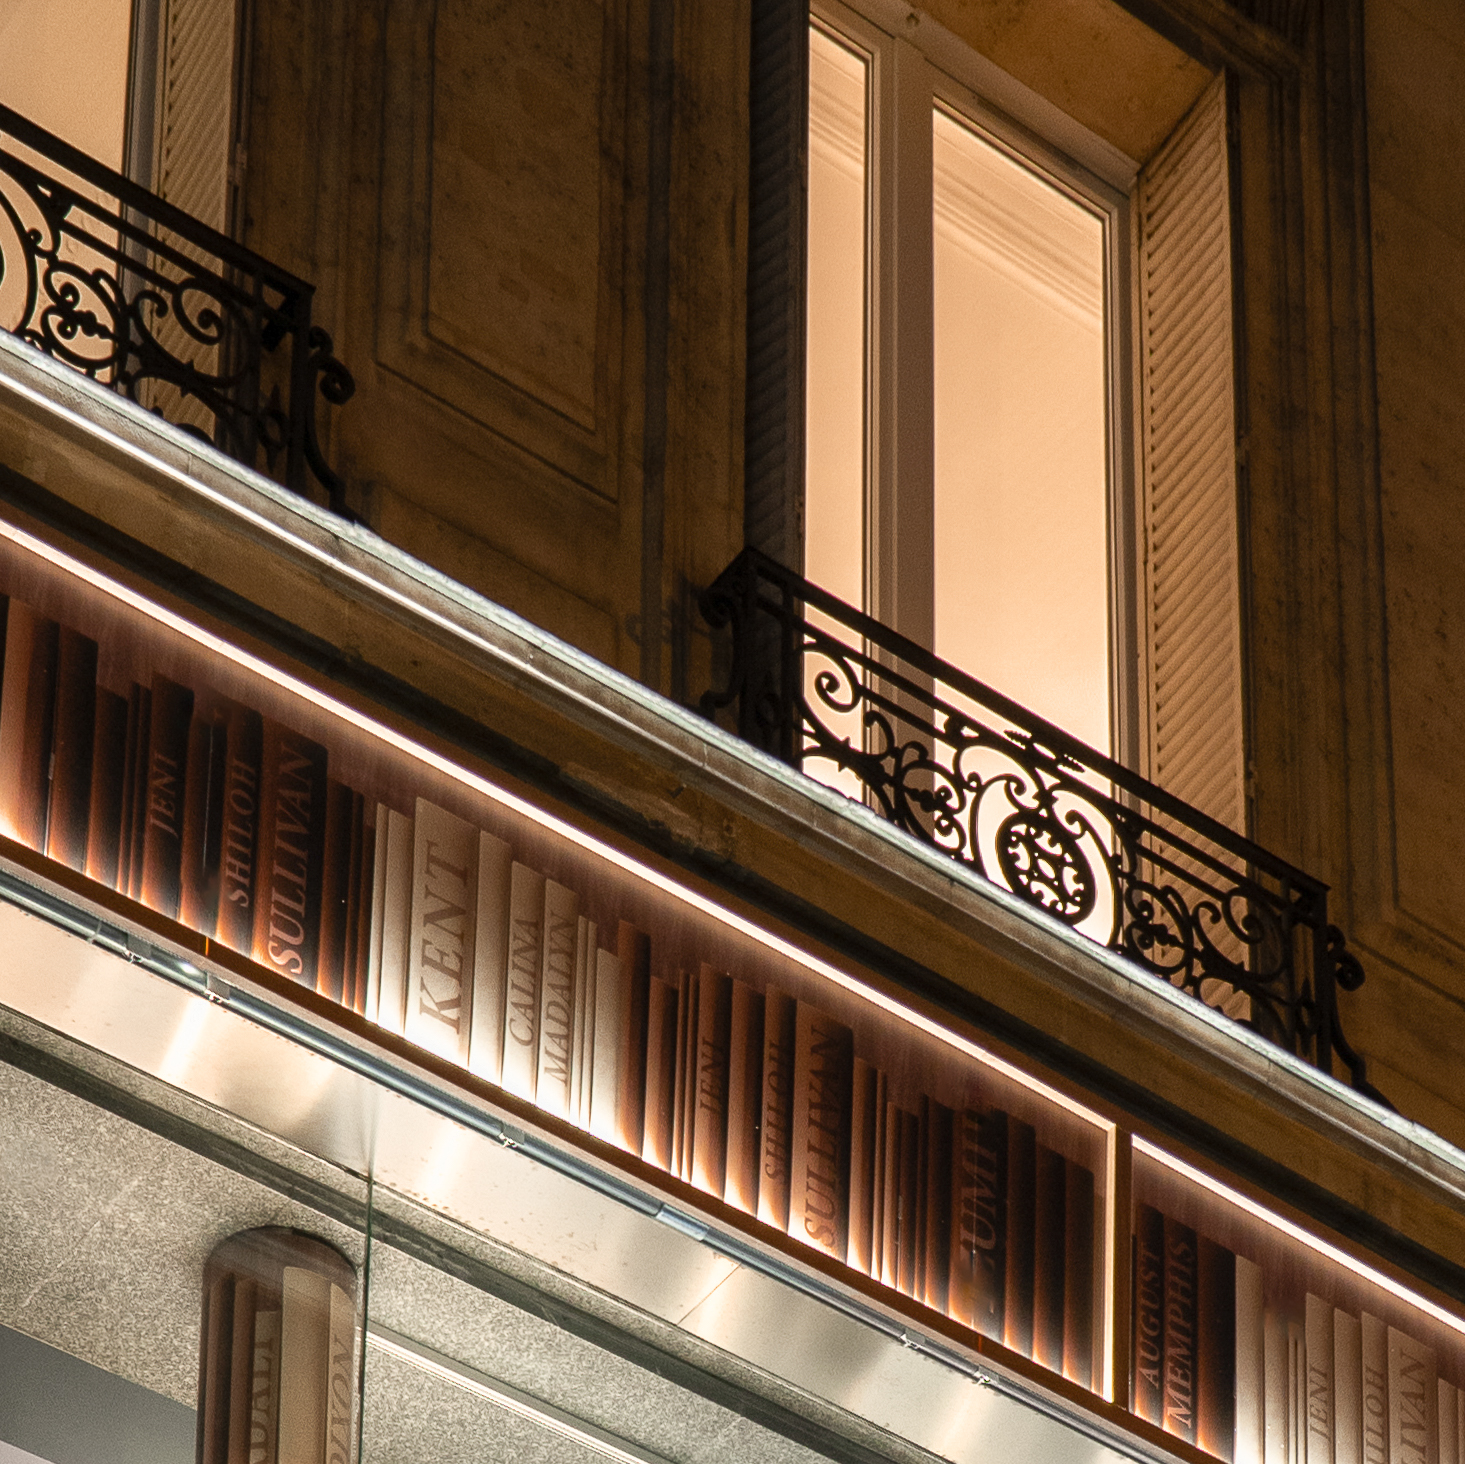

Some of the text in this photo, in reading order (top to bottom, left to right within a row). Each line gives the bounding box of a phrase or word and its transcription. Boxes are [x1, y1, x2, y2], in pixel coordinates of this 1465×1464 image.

[150, 750, 178, 838] JENI
[227, 757, 258, 908] SHILOH
[268, 740, 313, 974] SULLIVAN
[419, 839, 469, 1035] KENT
[509, 917, 539, 1047] CALINA
[544, 910, 575, 1086] MADALYN
[804, 1023, 839, 1249] SULLIVAN
[1140, 1241, 1161, 1389] AUGUST
[1166, 1234, 1193, 1429] MEMPHIS
[1309, 1362, 1330, 1445] JENI
